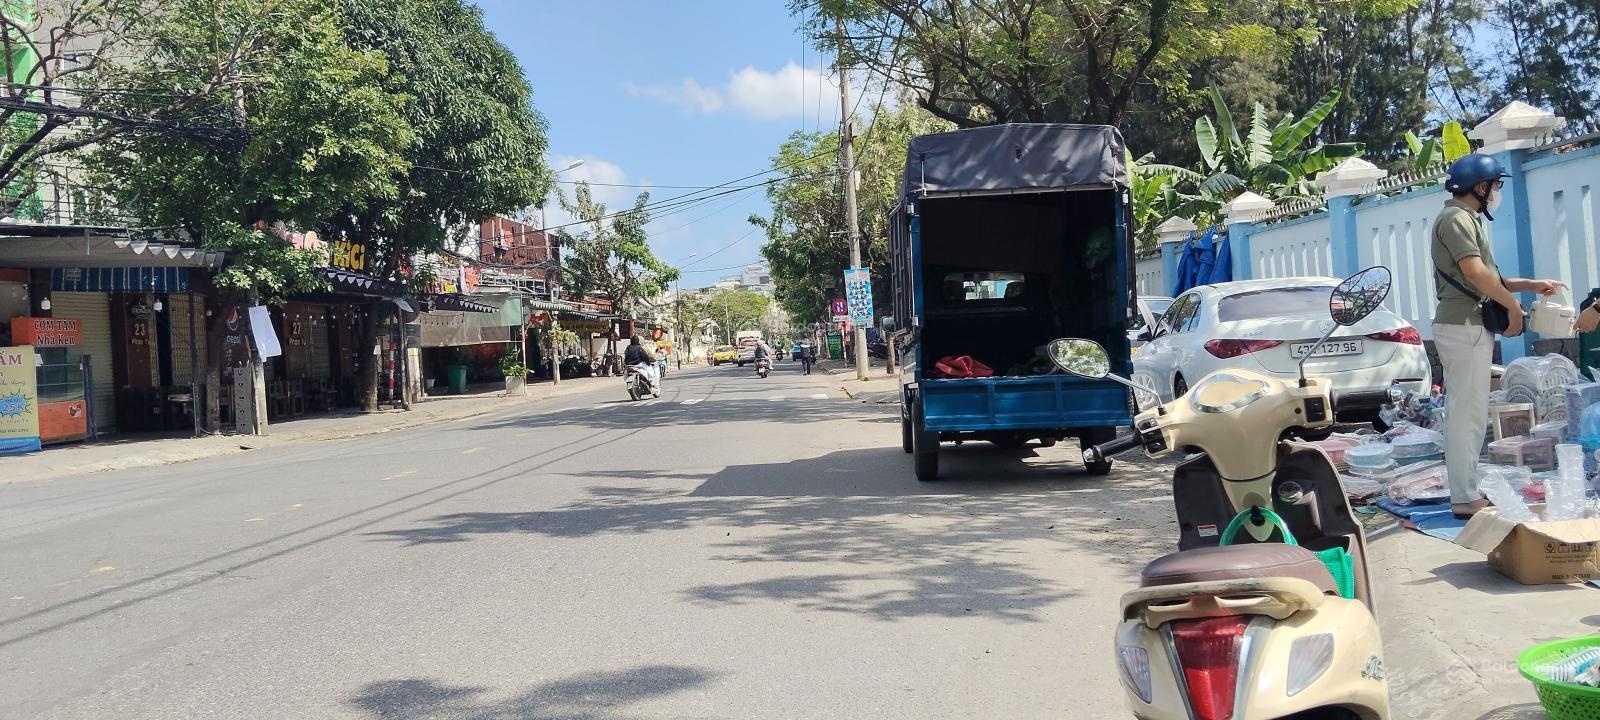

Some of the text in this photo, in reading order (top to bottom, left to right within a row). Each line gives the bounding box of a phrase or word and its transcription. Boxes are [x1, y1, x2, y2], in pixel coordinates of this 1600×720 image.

[134, 323, 145, 336] 23
[37, 332, 75, 345] Nhà Ken
[3, 403, 25, 412] 25K
